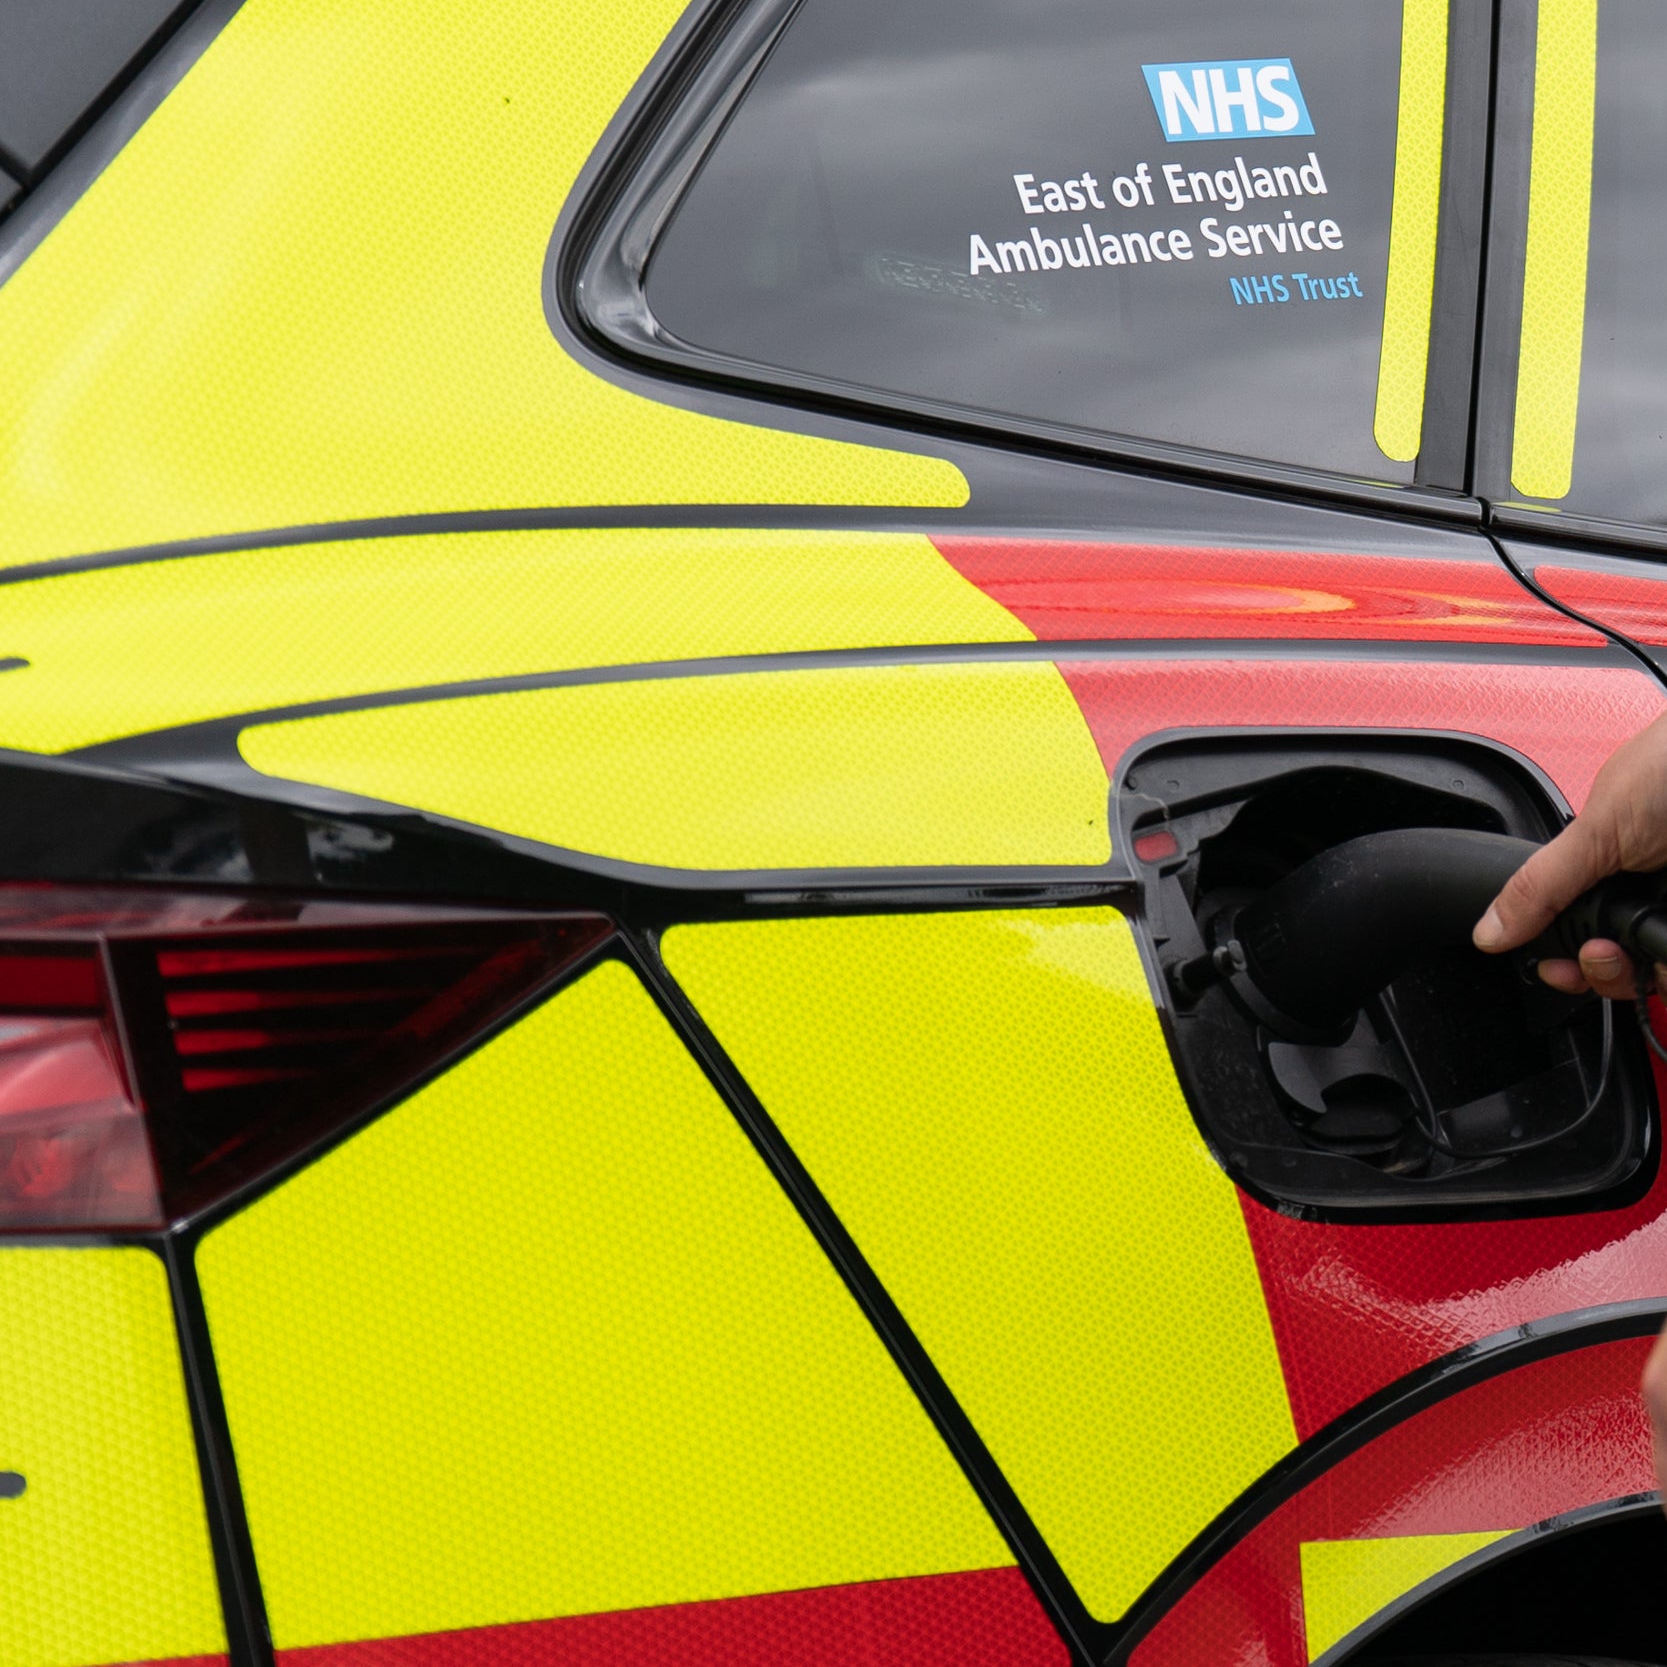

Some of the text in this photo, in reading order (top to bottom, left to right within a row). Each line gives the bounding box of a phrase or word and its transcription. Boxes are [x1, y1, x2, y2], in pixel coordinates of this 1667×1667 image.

[1157, 65, 1300, 135] NHS
[1012, 151, 1329, 215] East of England
[968, 210, 1344, 276] Ambulance Service
[1228, 271, 1364, 306] NHS Trust
